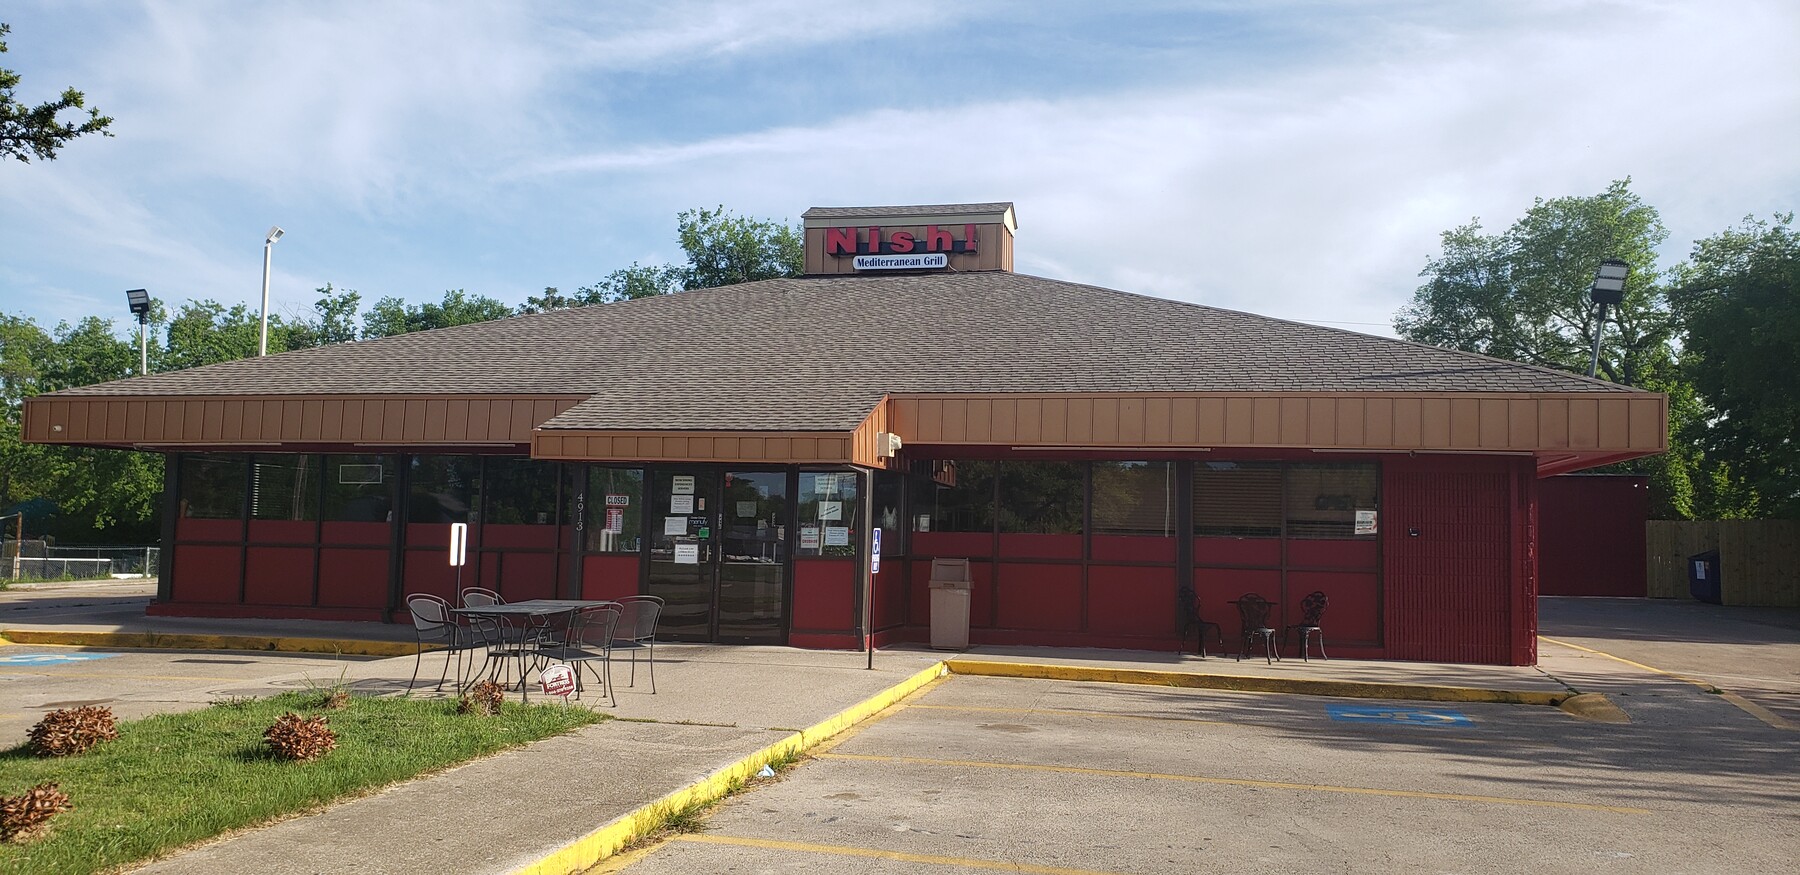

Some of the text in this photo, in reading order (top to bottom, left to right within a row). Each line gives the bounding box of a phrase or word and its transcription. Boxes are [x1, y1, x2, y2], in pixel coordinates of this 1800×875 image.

[827, 224, 976, 253] Nish!
[857, 256, 943, 267] Mediterranean Grill
[607, 496, 628, 504] CLOSED
[576, 493, 584, 531] 4913
